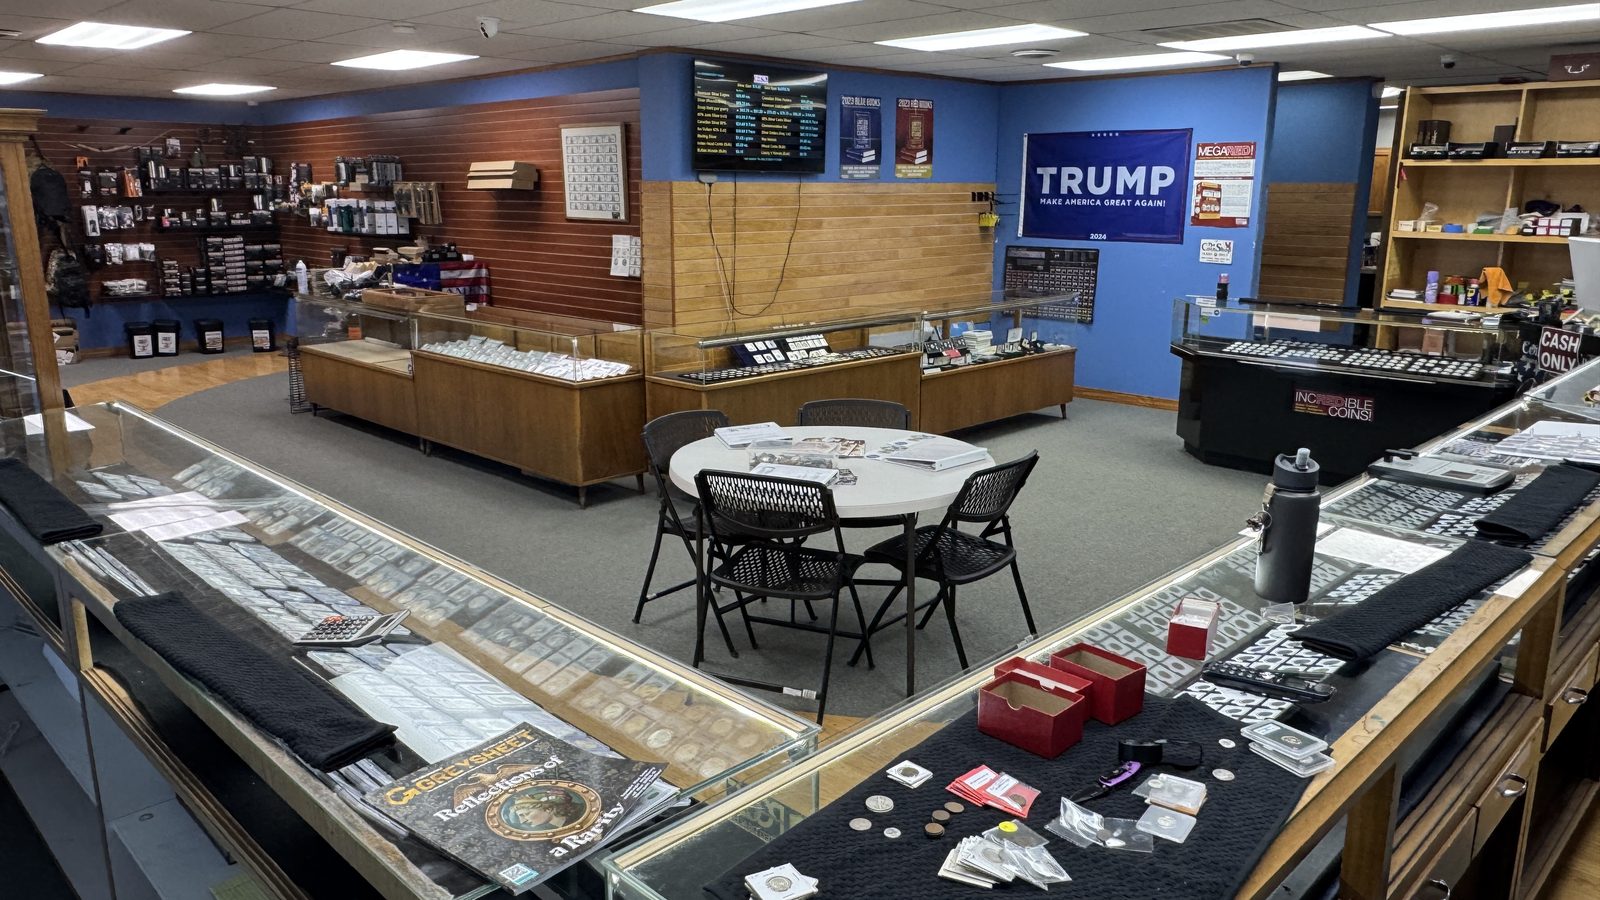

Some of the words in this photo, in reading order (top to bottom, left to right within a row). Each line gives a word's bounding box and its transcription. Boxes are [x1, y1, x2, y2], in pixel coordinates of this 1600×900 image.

[842, 96, 854, 105] 2023
[1036, 166, 1176, 196] TRUMP
[1040, 198, 1063, 206] MAKE
[1065, 198, 1102, 206] AMERICA
[1104, 199, 1132, 207] GREAT
[1134, 199, 1166, 208] AGAIN!
[1541, 331, 1580, 353] CASH
[1541, 352, 1577, 372] ONLY
[1295, 391, 1374, 411] INCREDIBLE
[1328, 406, 1373, 422] COINS!
[415, 730, 535, 792] GREYSHEET
[433, 765, 545, 822] Reflections
[543, 754, 565, 770] of
[549, 847, 569, 858] a
[561, 801, 625, 847] Rarity
